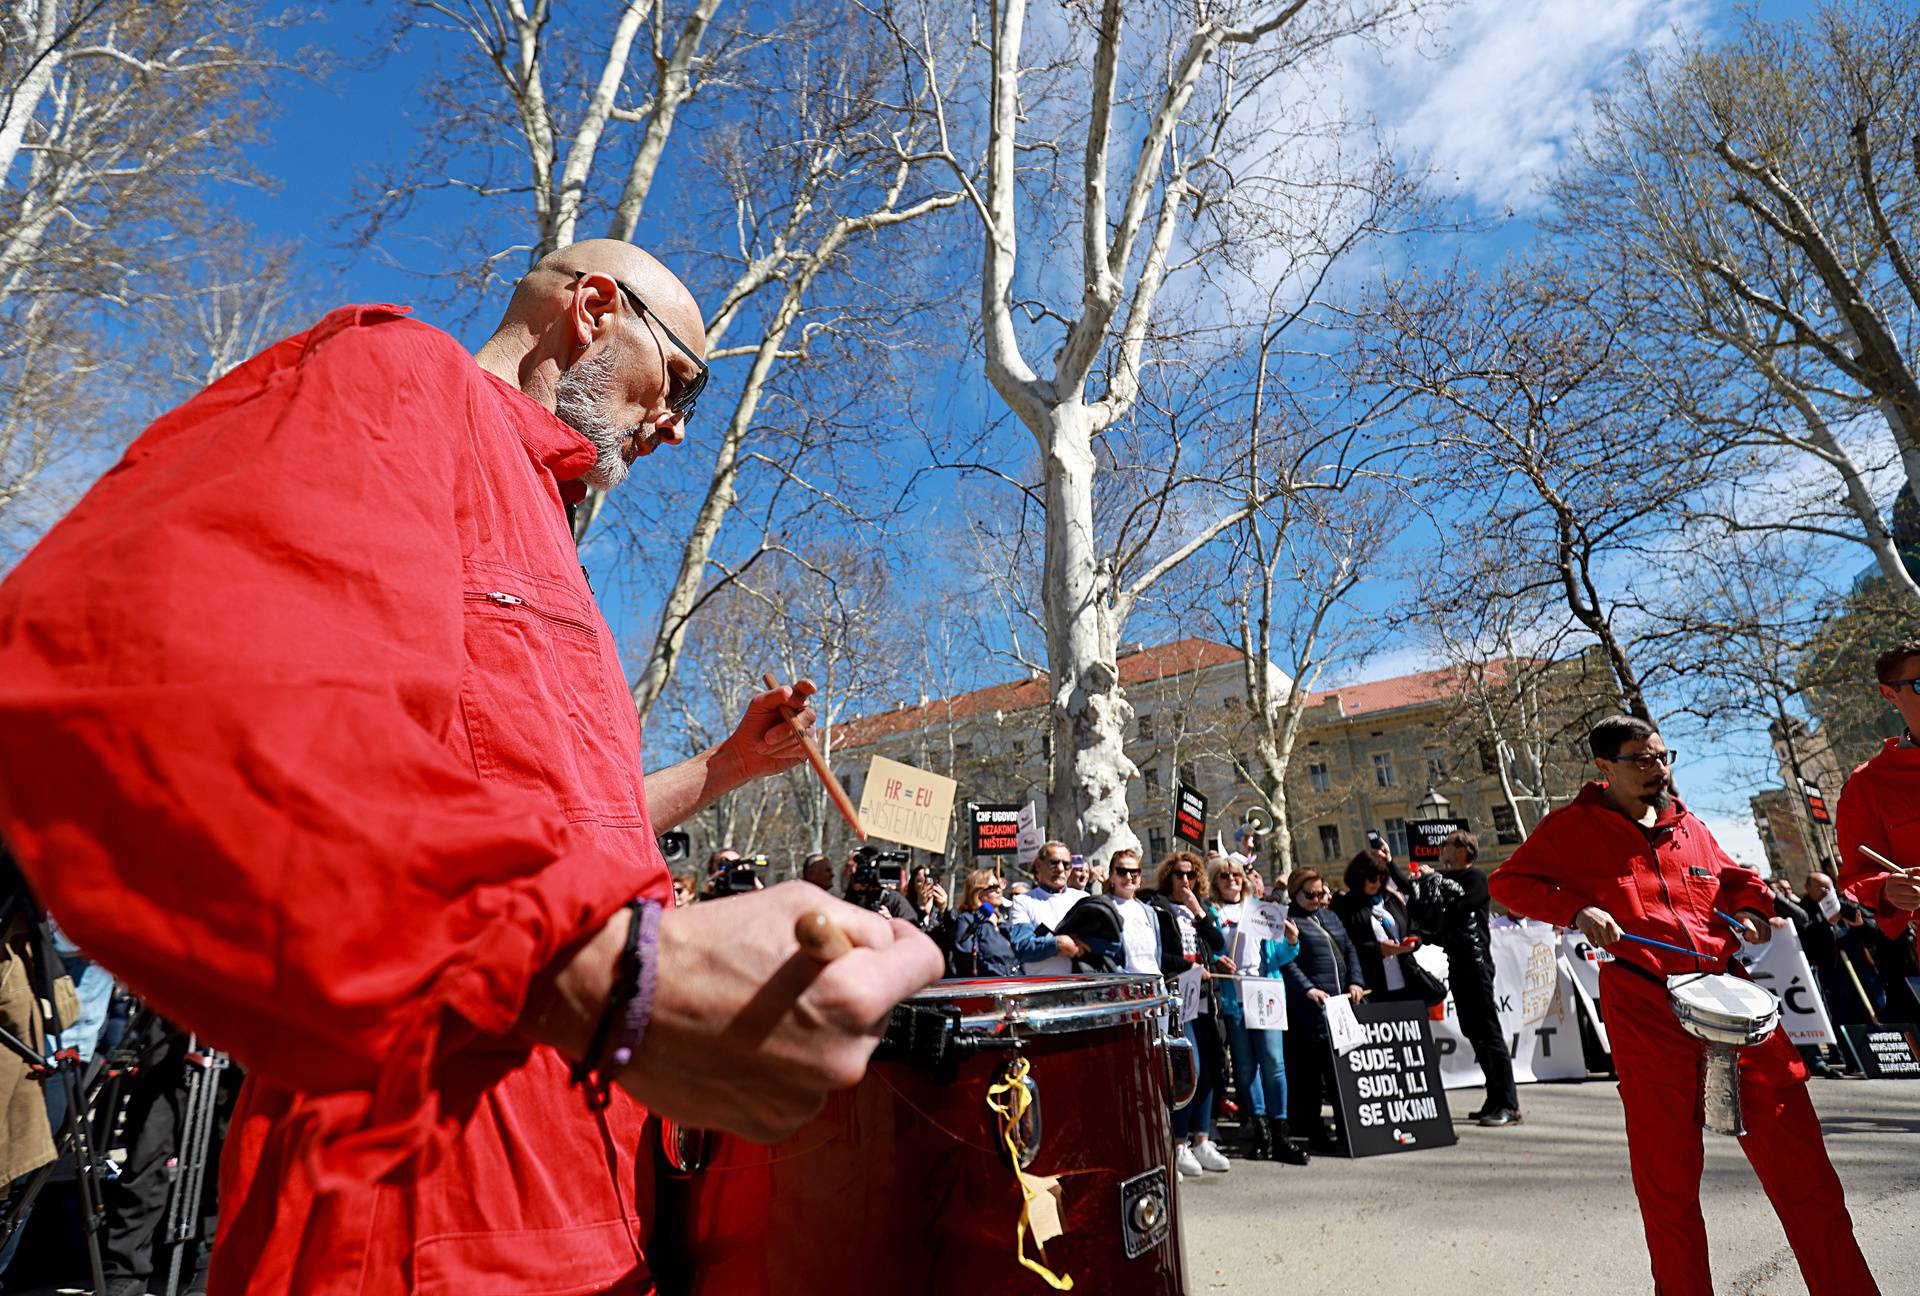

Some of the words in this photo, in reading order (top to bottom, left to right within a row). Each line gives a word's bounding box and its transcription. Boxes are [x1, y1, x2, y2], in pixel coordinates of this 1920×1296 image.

[884, 778, 902, 801] HR
[915, 787, 933, 808] EU
[976, 811, 992, 823] CHF
[1418, 824, 1457, 834] VRHOVNI
[979, 824, 1017, 835] NEZAKONIT
[1359, 1020, 1422, 1044] RHOVNI
[1348, 1048, 1402, 1073] SUDE,
[1403, 1045, 1425, 1067] ILI
[1357, 1073, 1404, 1099] SUDI,
[1405, 1071, 1428, 1093] ILI
[1358, 1102, 1385, 1127] SE
